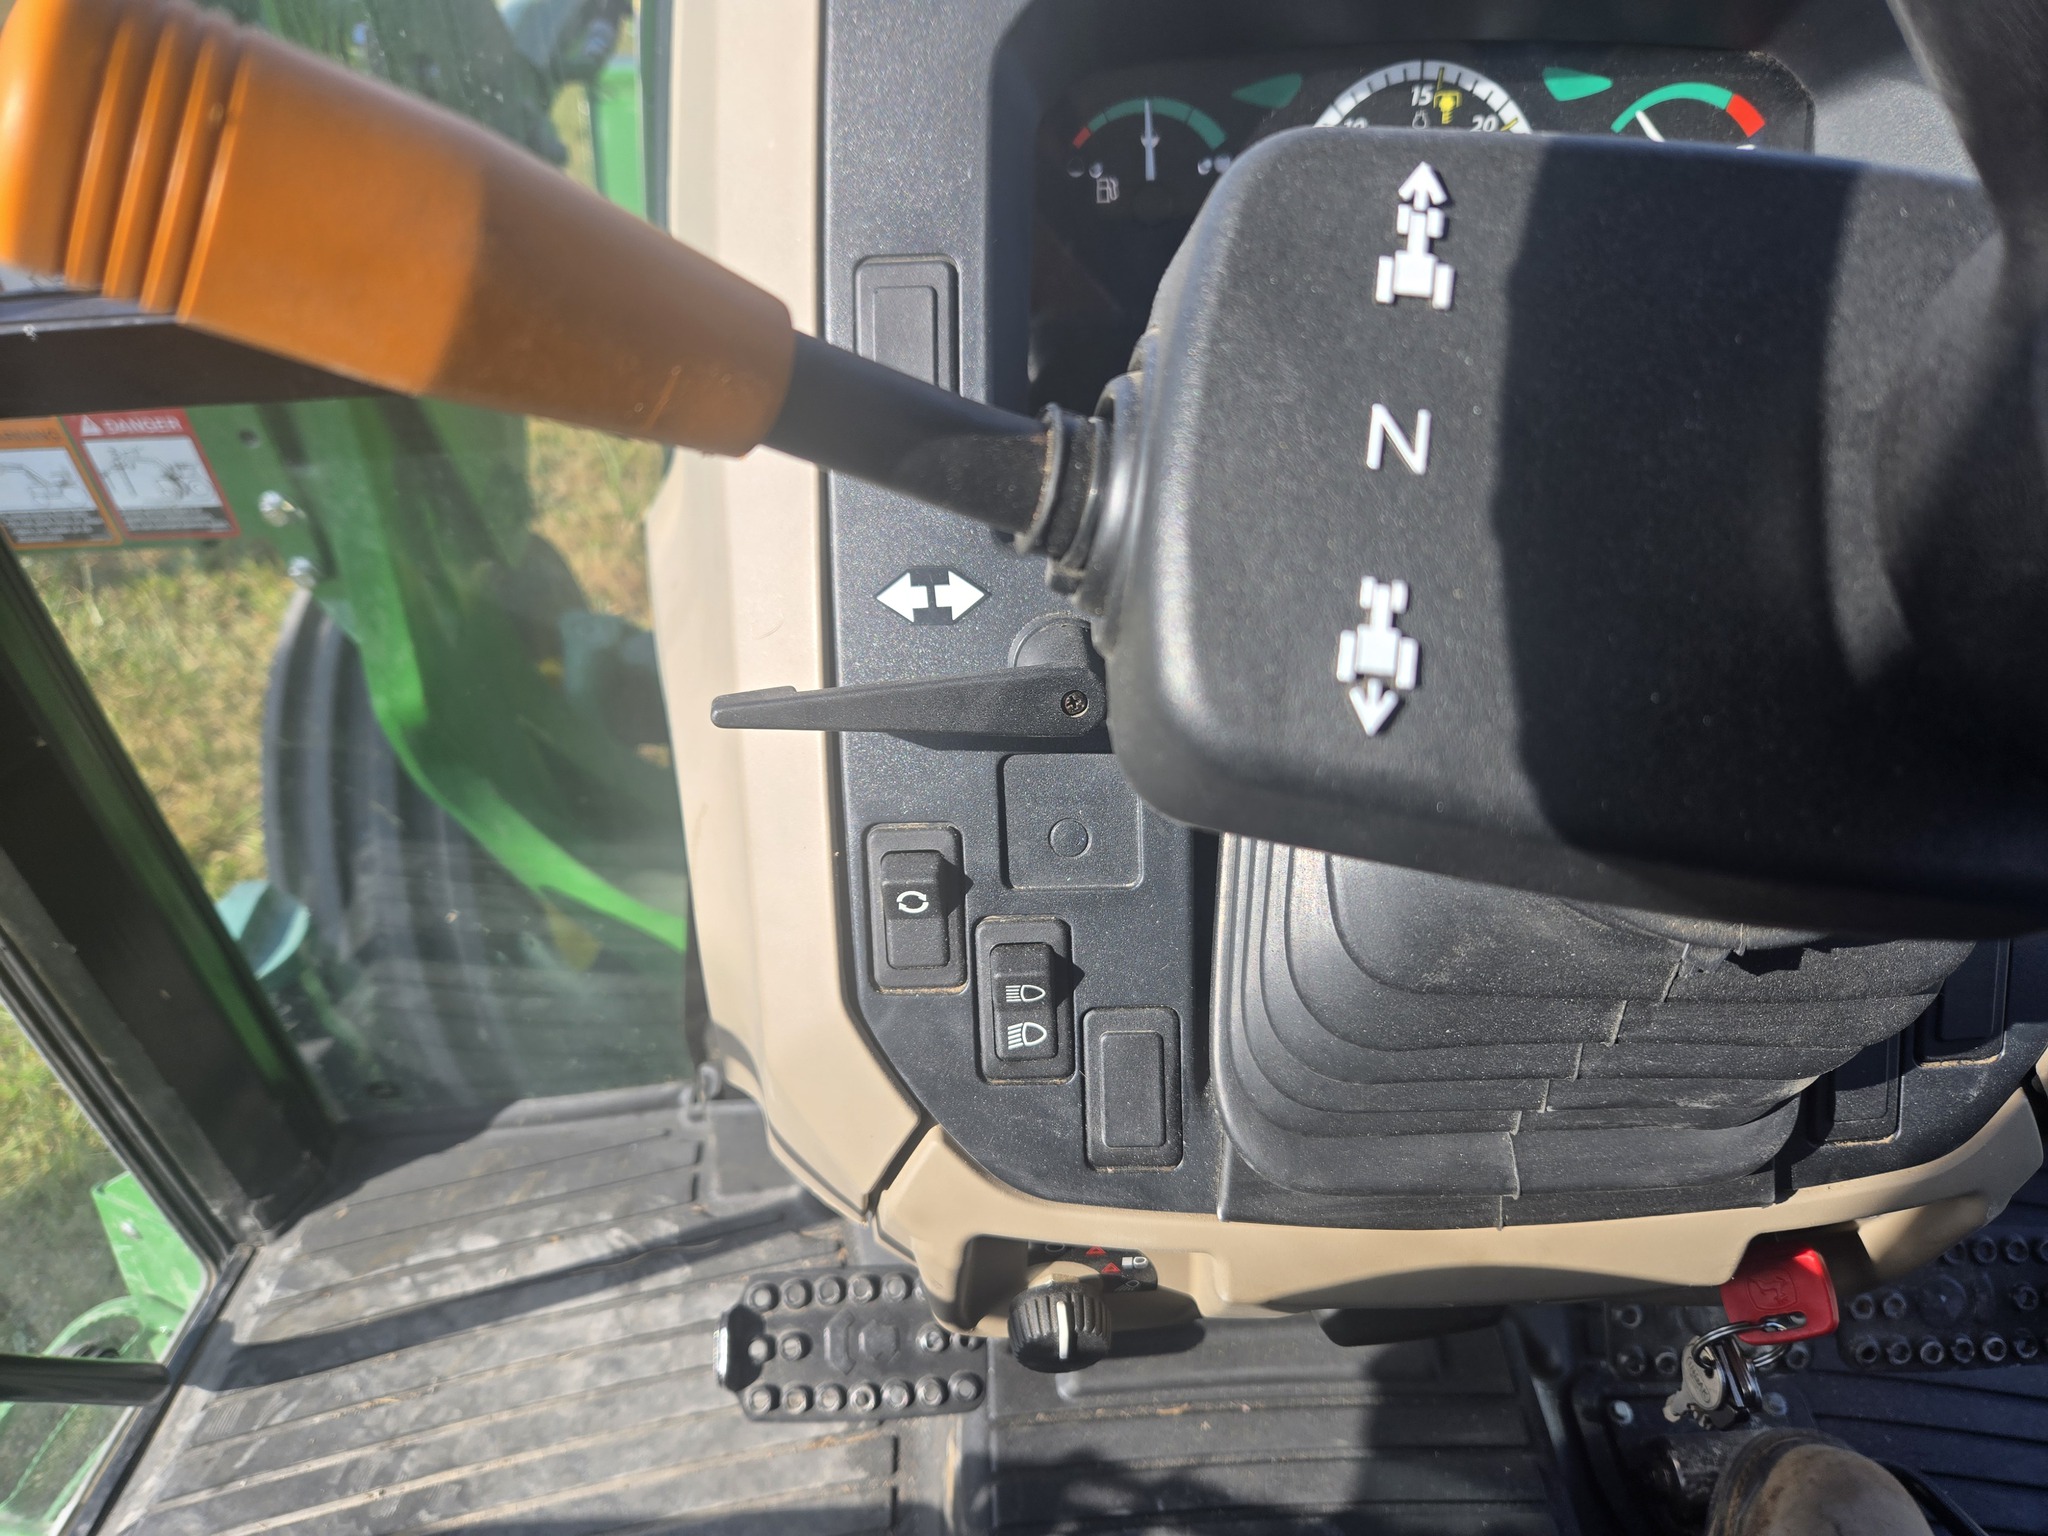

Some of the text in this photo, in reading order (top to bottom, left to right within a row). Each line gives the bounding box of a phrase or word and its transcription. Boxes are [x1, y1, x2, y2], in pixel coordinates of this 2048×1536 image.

[1411, 84, 1435, 107] 15
[1470, 114, 1499, 132] 20
[102, 415, 183, 435] DANGER
[1366, 403, 1432, 476] N
